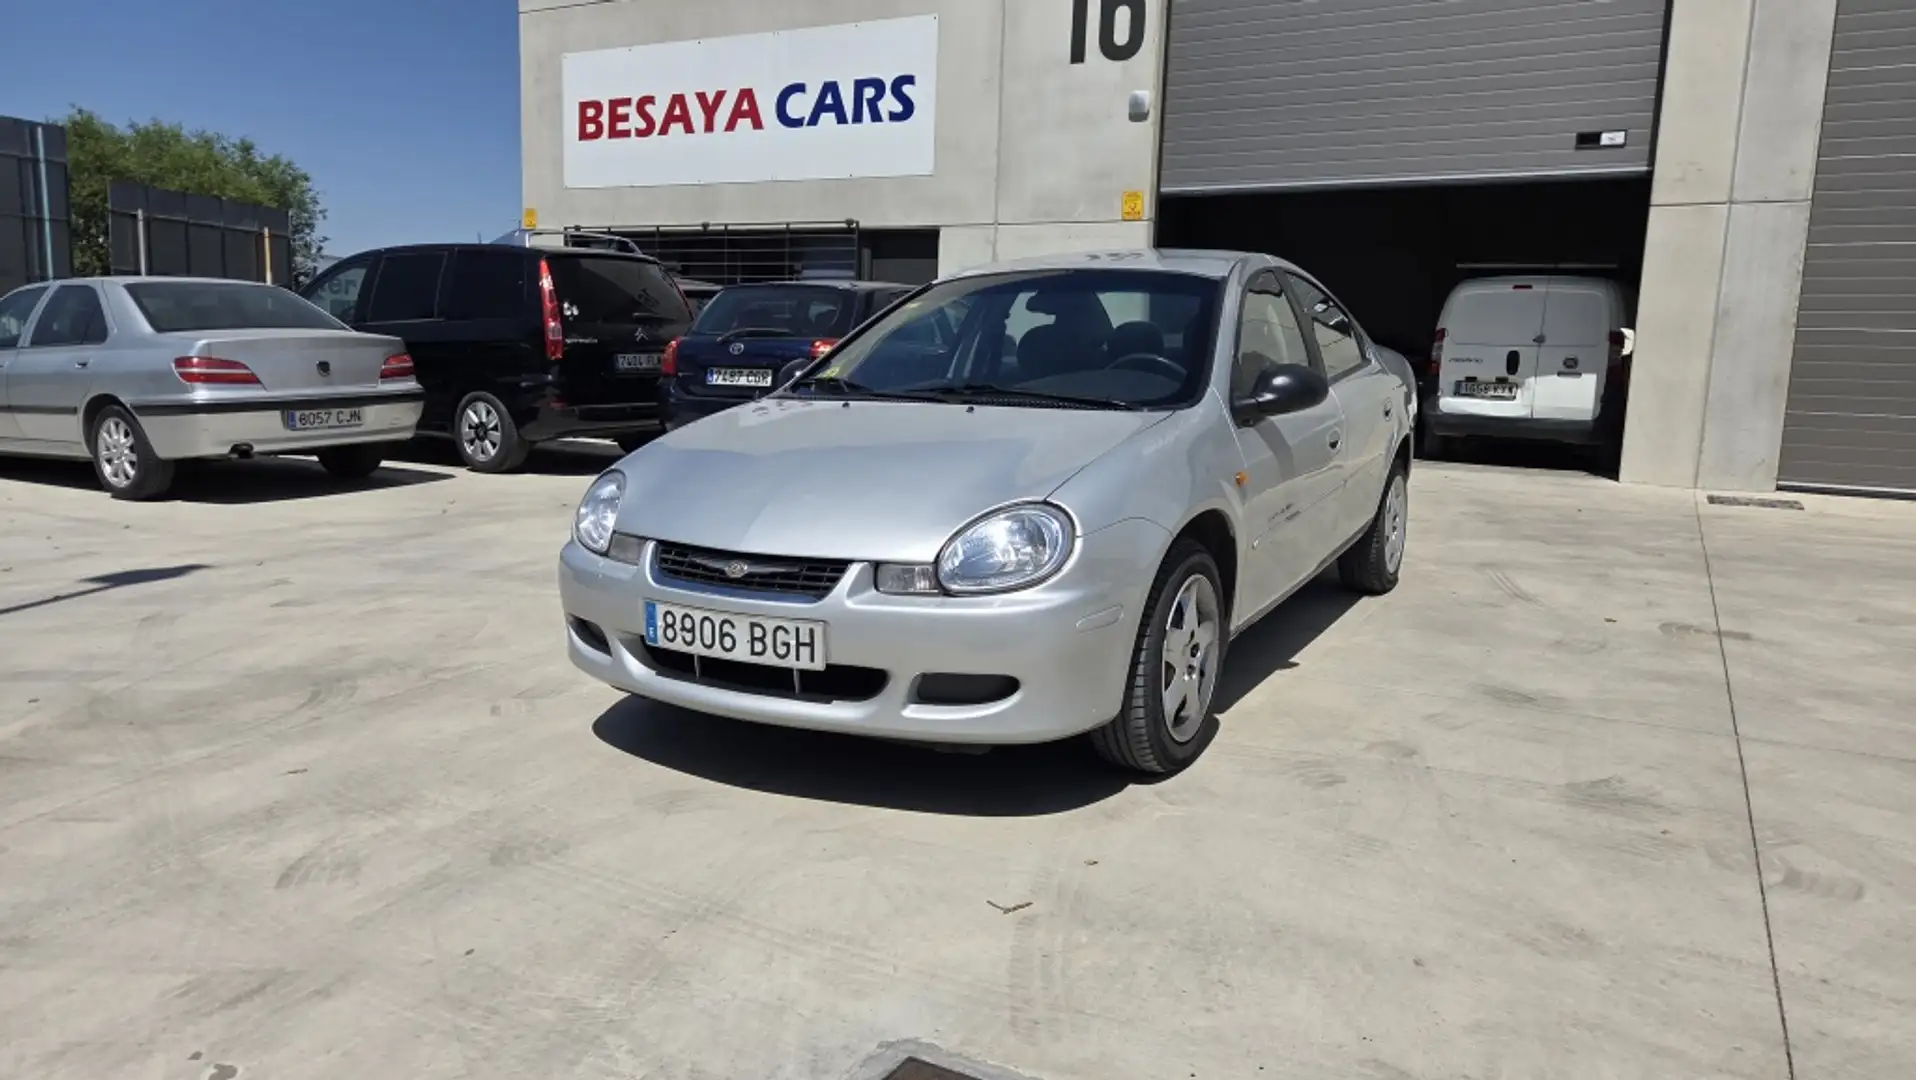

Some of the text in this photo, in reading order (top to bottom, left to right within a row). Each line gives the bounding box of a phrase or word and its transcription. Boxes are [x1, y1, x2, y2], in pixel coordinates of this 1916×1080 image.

[578, 74, 916, 142] BESAYA CARS
[336, 409, 362, 425] CJN
[662, 610, 737, 653] 8906
[750, 621, 816, 664] BGH
